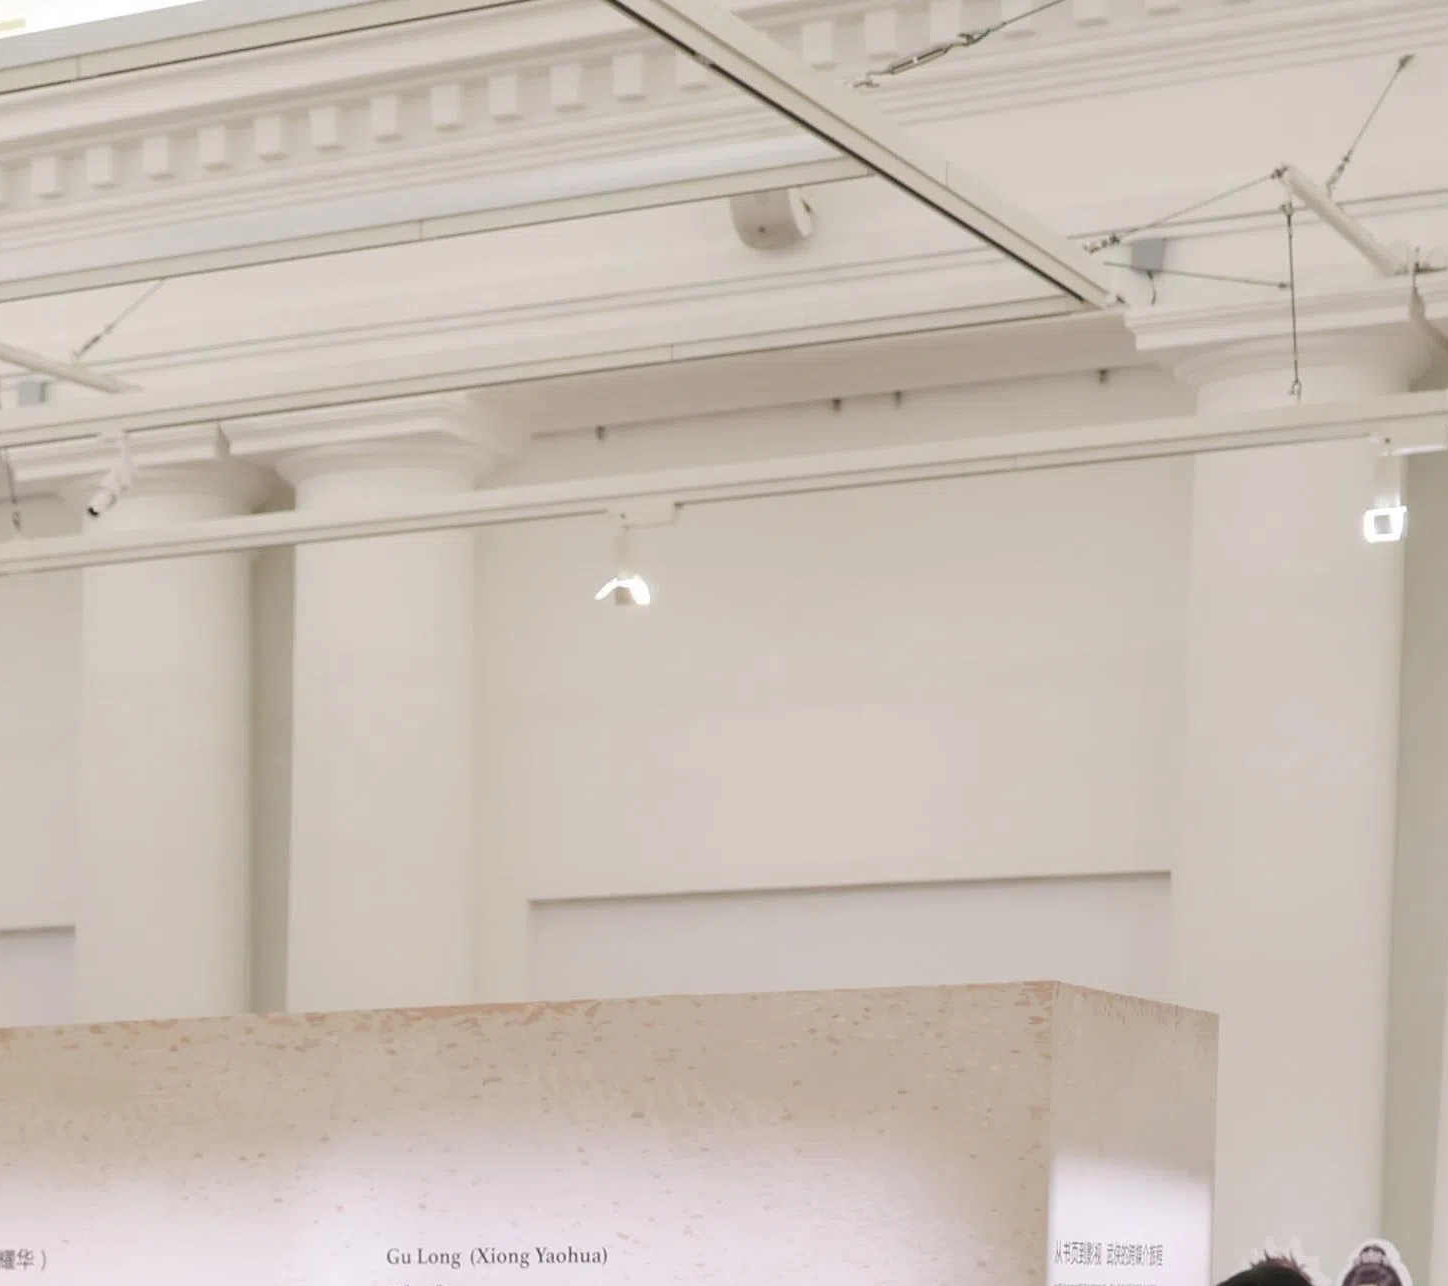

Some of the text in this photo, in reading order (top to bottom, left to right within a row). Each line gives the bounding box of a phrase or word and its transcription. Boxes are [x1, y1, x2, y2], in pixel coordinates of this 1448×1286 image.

[386, 1246, 608, 1269] Gu Long (Xiong Yaohua)
